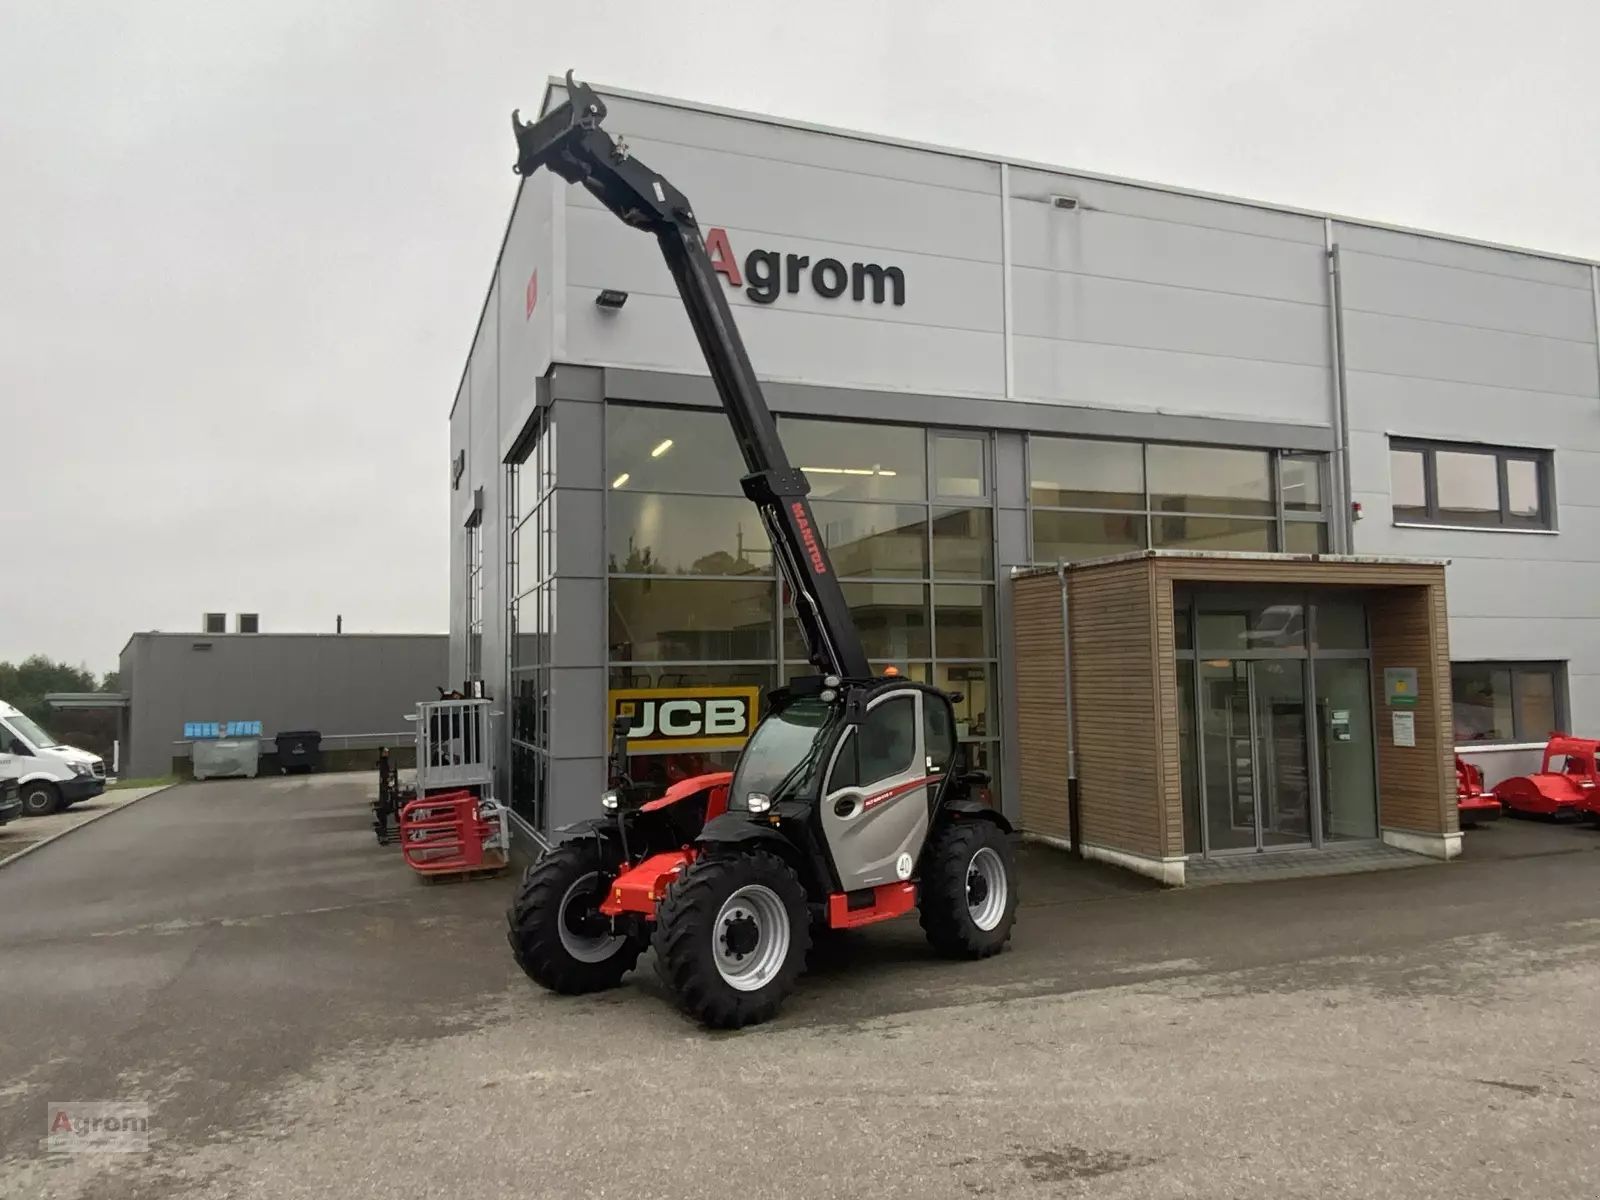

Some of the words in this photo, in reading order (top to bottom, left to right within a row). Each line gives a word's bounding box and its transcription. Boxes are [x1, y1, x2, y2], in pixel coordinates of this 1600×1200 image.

[704, 228, 905, 306] Agrom
[791, 501, 827, 574] MANITOU
[626, 699, 746, 738] JCB
[899, 857, 910, 874] 40
